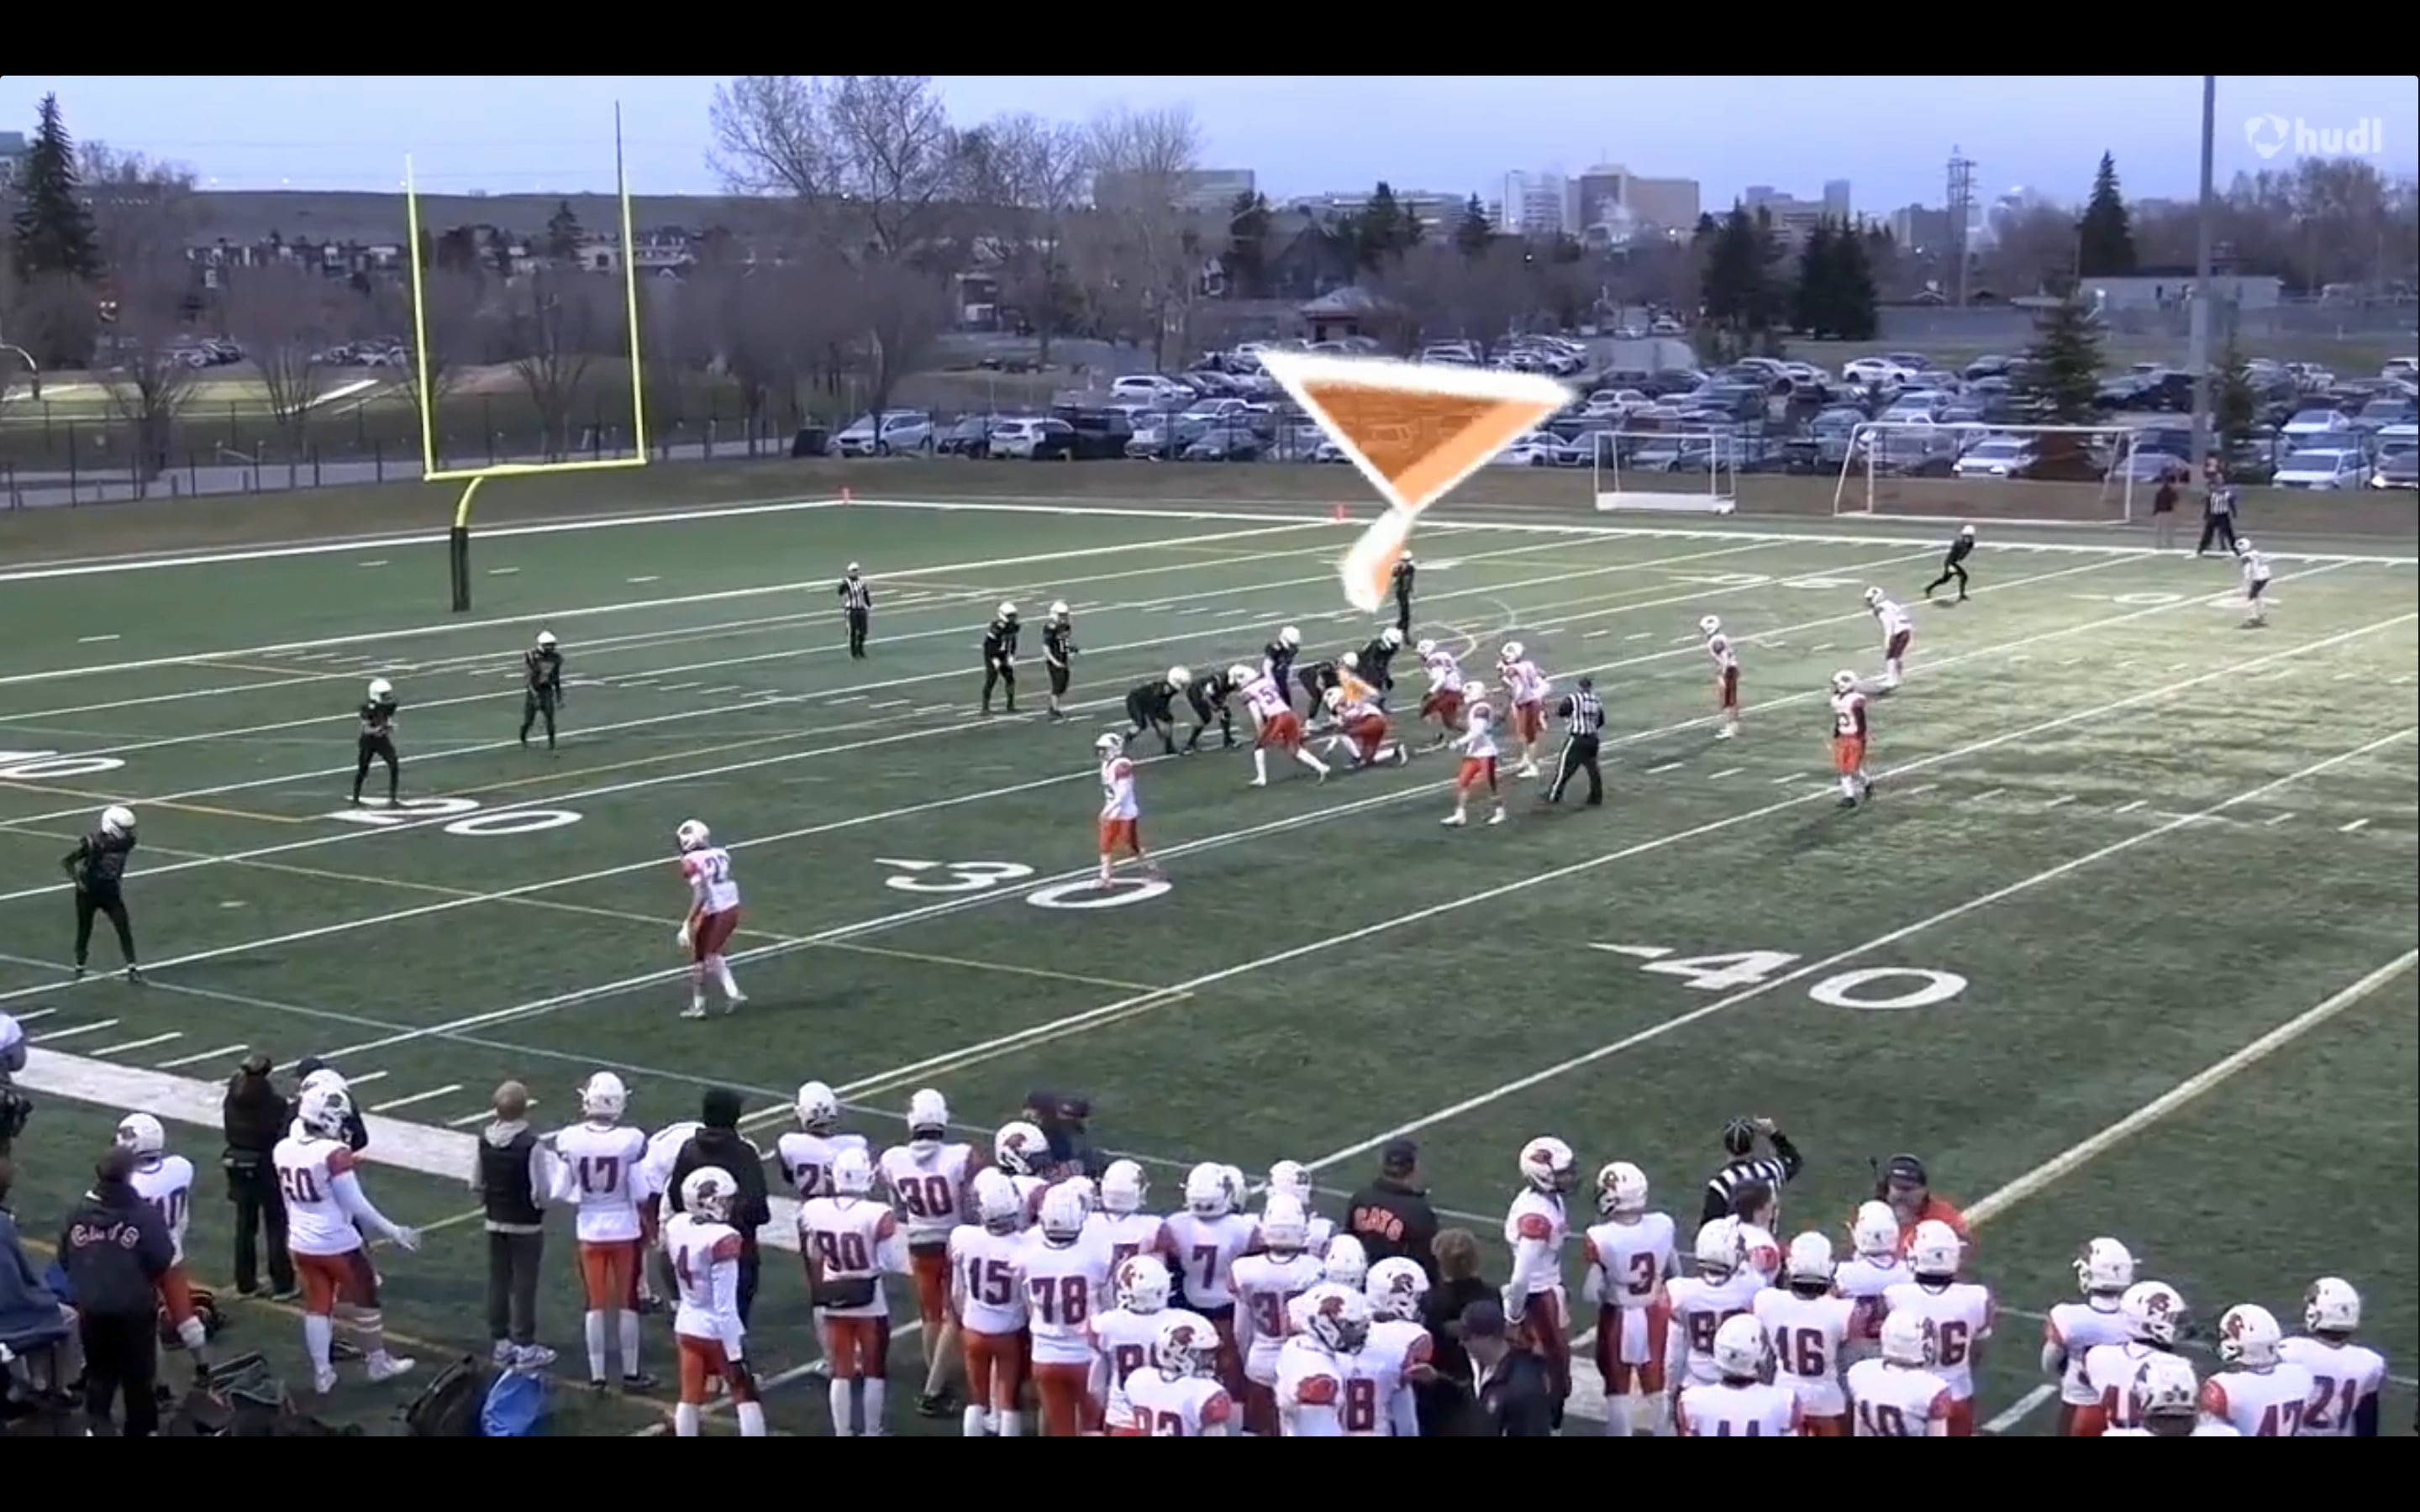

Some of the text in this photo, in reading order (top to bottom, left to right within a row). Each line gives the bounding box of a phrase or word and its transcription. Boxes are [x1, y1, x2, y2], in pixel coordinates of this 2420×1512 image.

[323, 796, 583, 836] 20
[885, 861, 1173, 908] 30
[1640, 950, 1968, 1009] 40
[797, 1163, 834, 1197] 2
[897, 1175, 954, 1218] 30
[969, 1257, 1013, 1305] 15
[1192, 1244, 1218, 1290] 7
[1628, 1252, 1655, 1295] 3
[1031, 1275, 1087, 1325] 78
[1689, 1310, 1749, 1358] 8
[1776, 1326, 1824, 1377] 16
[2302, 1375, 2357, 1431] 21
